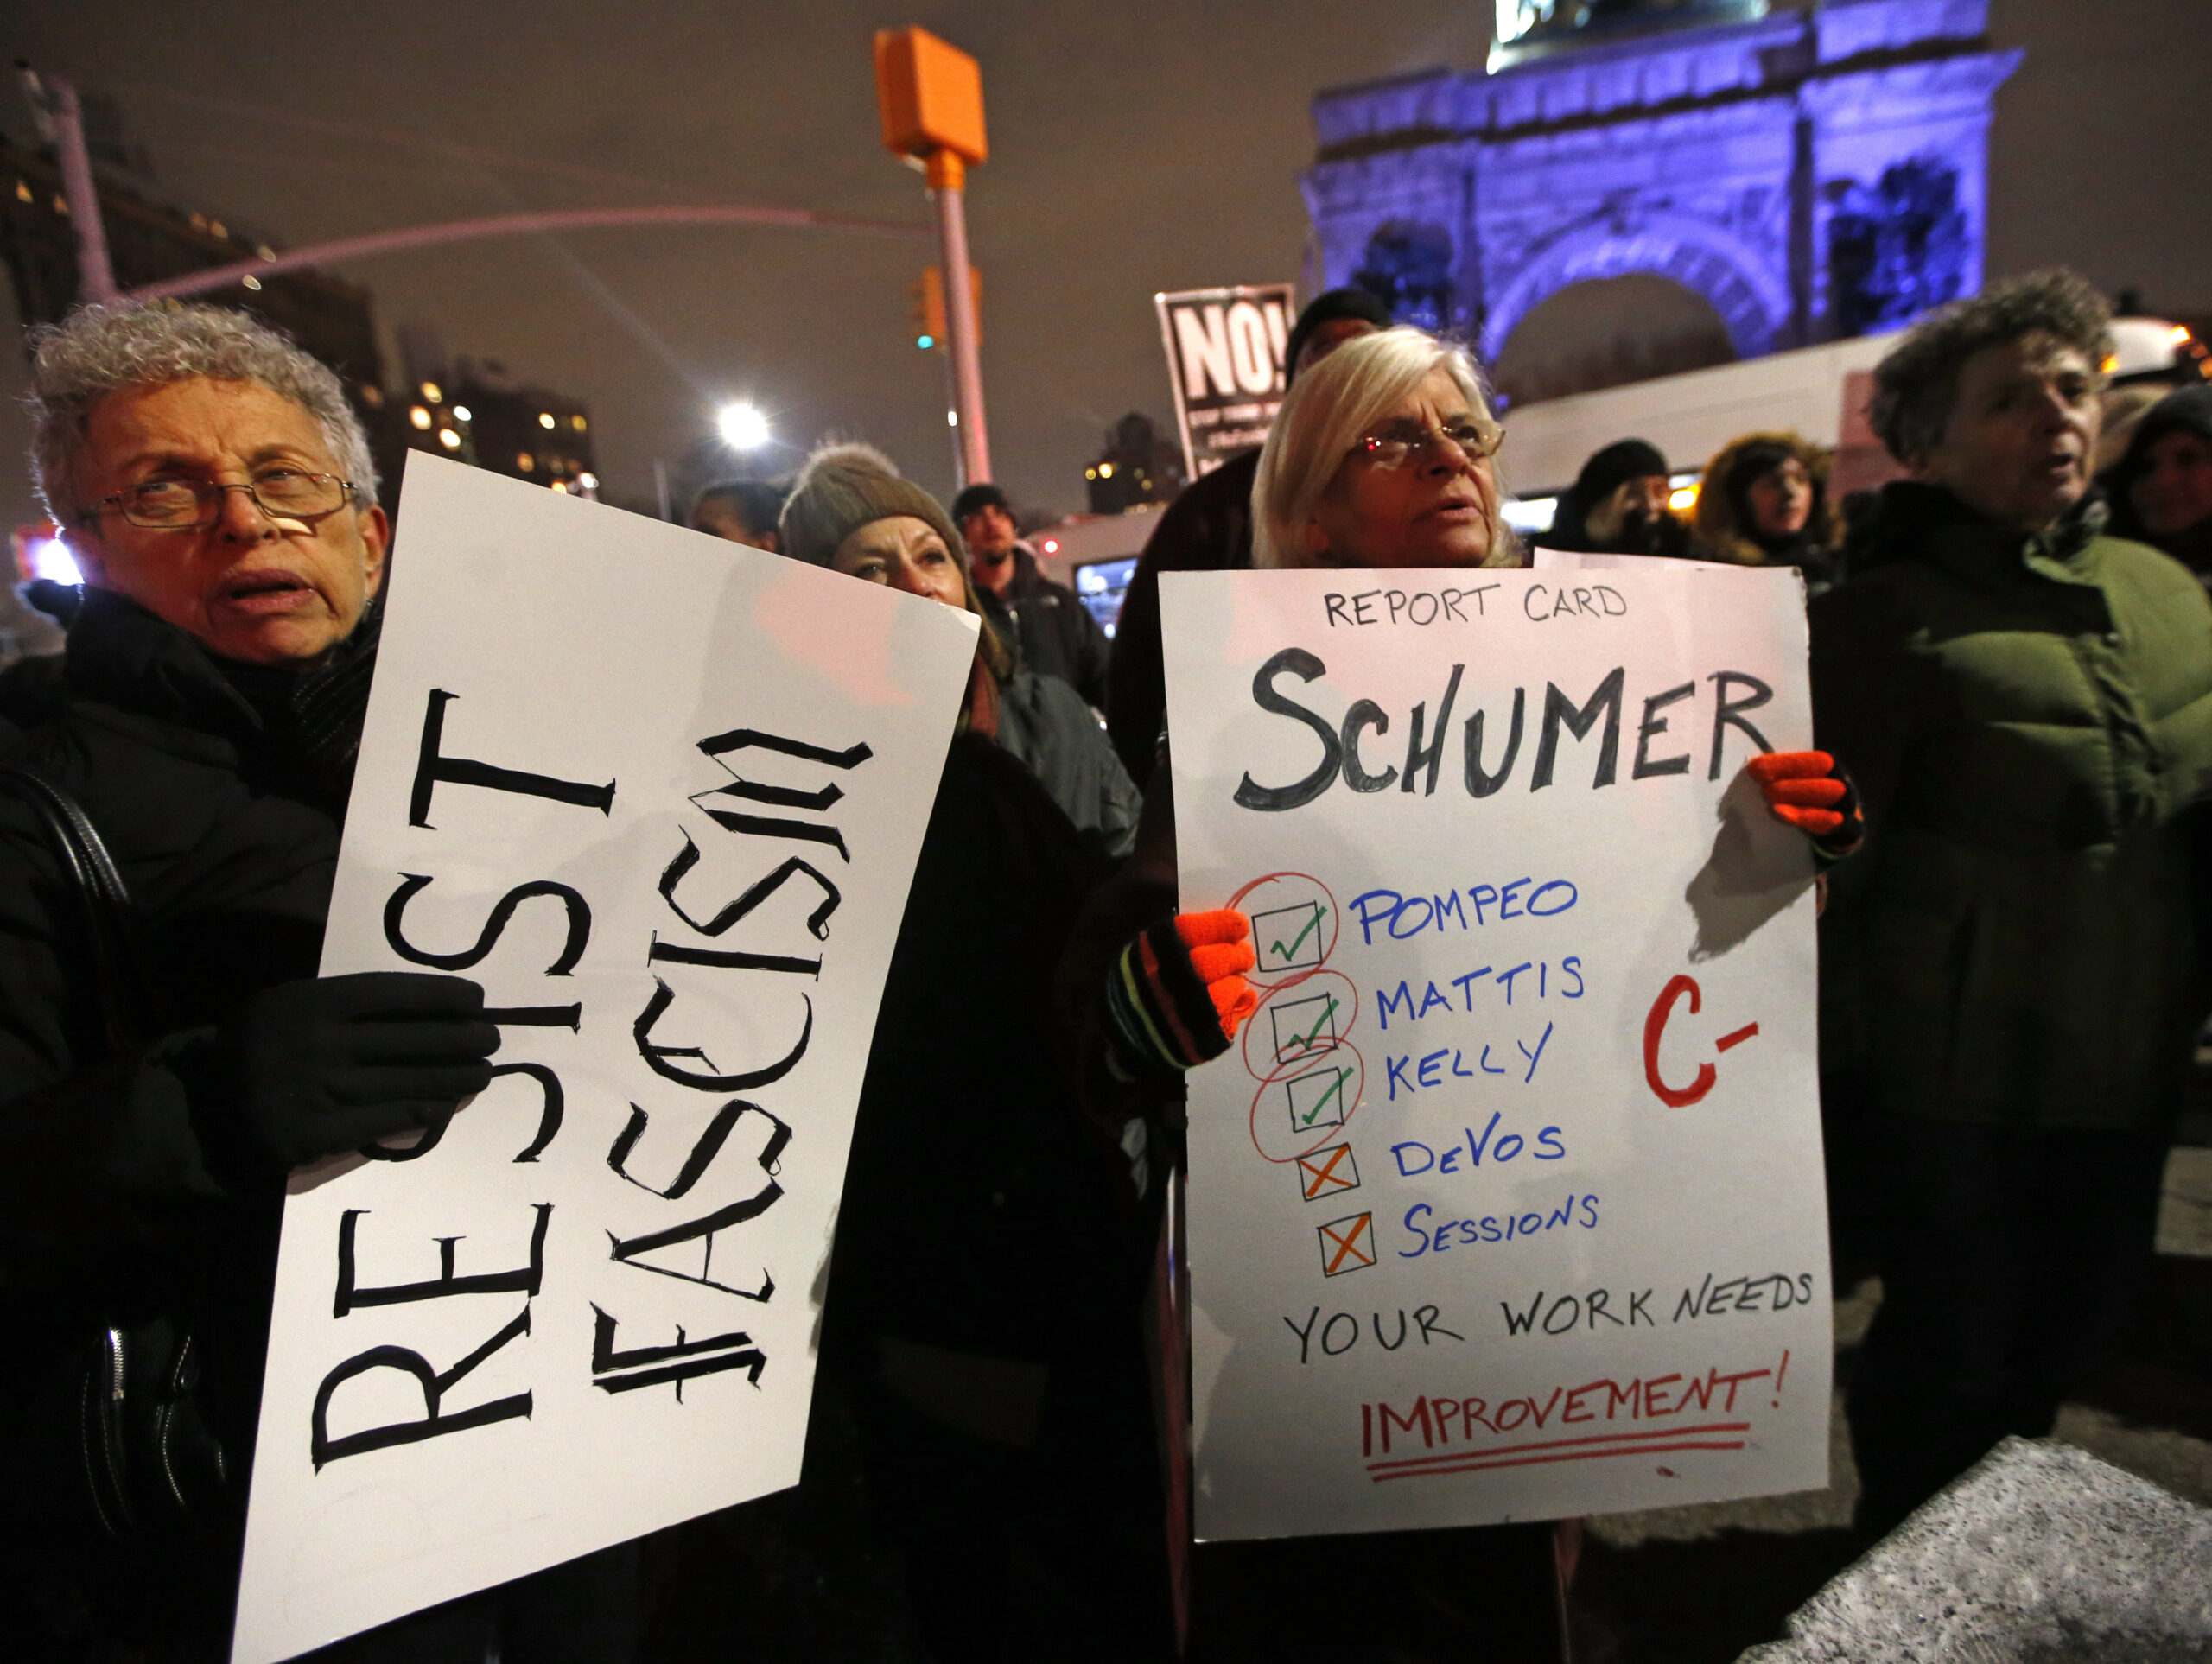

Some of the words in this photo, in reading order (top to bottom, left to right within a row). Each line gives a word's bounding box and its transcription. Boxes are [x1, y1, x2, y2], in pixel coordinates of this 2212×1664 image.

[1173, 302, 1287, 400] NO!
[1325, 584, 1500, 626] REPORT
[1524, 584, 1626, 621] CARD
[1233, 647, 1775, 811] SCHUMER
[1349, 878, 1578, 945] POMPEO
[1376, 956, 1585, 1029] MATTIS
[591, 728, 873, 1404] FASCISM
[1385, 1021, 1554, 1101] KELLY
[1643, 974, 1759, 1108] C-
[1399, 1195, 1599, 1258] SESSIONS
[1284, 1305, 1465, 1364] YOUR
[1500, 1289, 1656, 1337] WORK
[1673, 1273, 1813, 1324] NEEDS
[1361, 1350, 1789, 1458] IMPROVEMENT!
